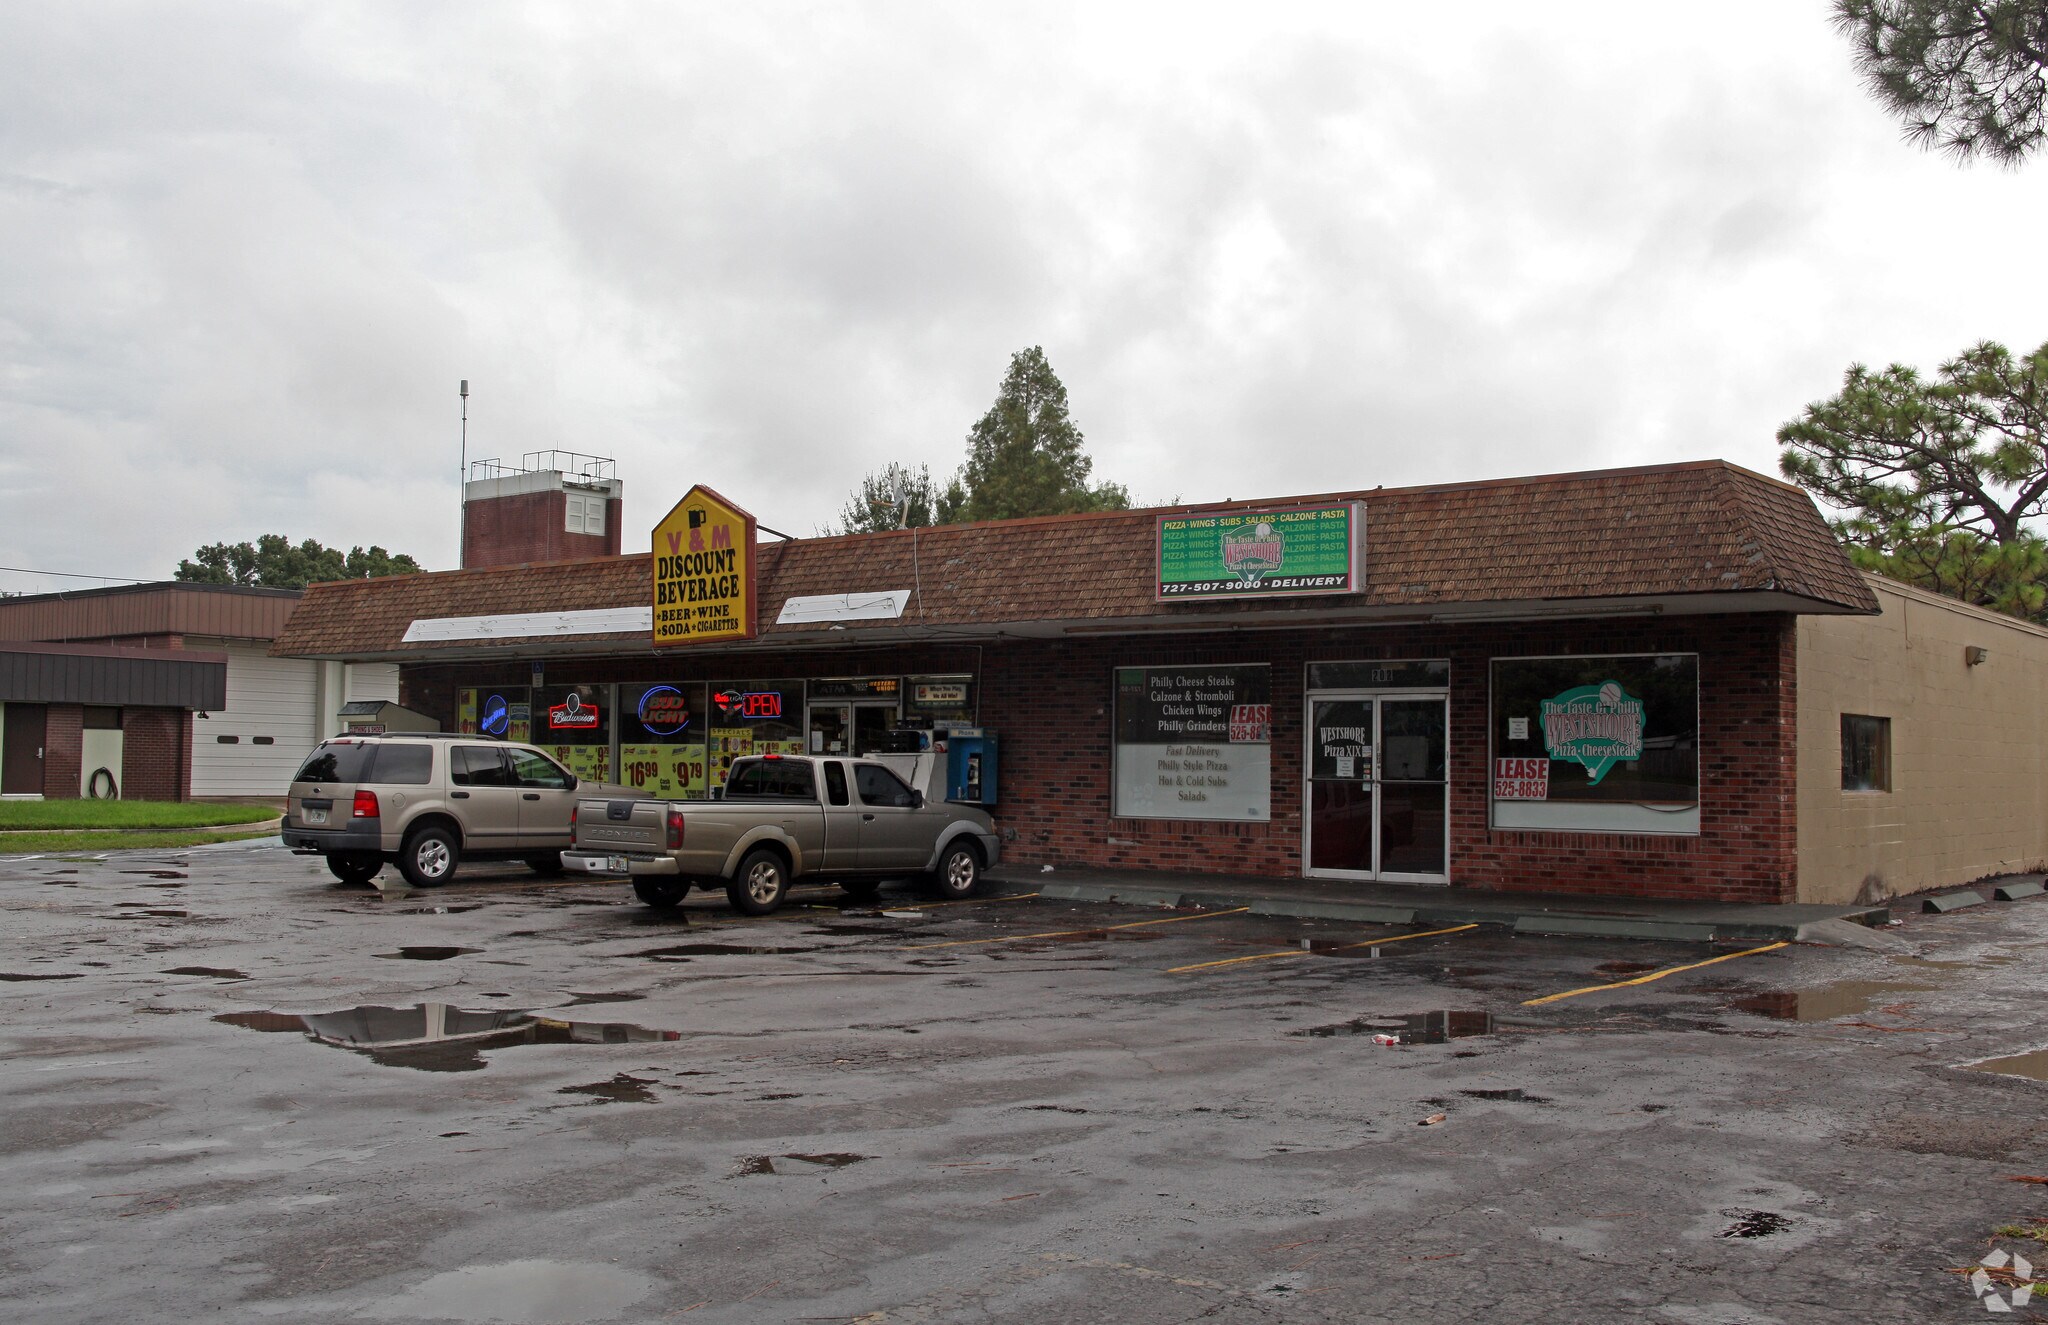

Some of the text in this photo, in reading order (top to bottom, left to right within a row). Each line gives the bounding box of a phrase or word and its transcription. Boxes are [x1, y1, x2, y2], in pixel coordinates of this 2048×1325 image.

[1164, 510, 1345, 530] PIZZA WINGS SUBS SALADS CALZONE PASTA
[1163, 532, 1186, 540] PIZZA
[1189, 530, 1214, 539] WINGS
[1320, 521, 1346, 530] PASTA
[666, 524, 731, 555] V & M
[1163, 531, 1345, 550] PIZZA WINGS ALZONE PASTA
[1237, 535, 1254, 543] Taste
[1263, 534, 1280, 543] Philly
[1163, 542, 1345, 560] PIZZA WINGS ALZONE PASTA
[1225, 542, 1281, 565] WESTSHORE
[658, 548, 736, 580] DISCOUNT
[1284, 555, 1317, 563] ALZONE
[657, 574, 739, 605] BEVERAGE
[1162, 576, 1345, 593] 727-507-9000 DELIVERY
[1151, 675, 1235, 689] Philly Cheese Steaks
[649, 696, 684, 710] BUD
[1150, 690, 1235, 702] Calzone & Stromboli
[744, 694, 780, 716] OPEN
[1162, 704, 1222, 717] Chicken Wings
[1544, 702, 1563, 714] The
[1565, 702, 1592, 714] Taste
[1610, 700, 1640, 713] Philly
[640, 710, 689, 723] LIGHT
[712, 728, 751, 736] SPECIALS
[1158, 720, 1227, 733] Philly Grinders
[1544, 713, 1641, 750] WESTSHORE
[1320, 726, 1366, 745] WESTSHORE
[1166, 745, 1220, 758] Fast Delivery
[1324, 745, 1345, 757] Pizza
[1346, 745, 1361, 757] XIX
[1553, 744, 1577, 756] Pizza
[1157, 760, 1228, 772] Philly Style Pizza
[1496, 759, 1547, 780] LEASE
[1158, 775, 1228, 787] Hot & Cold Subs
[1178, 790, 1207, 801] Salads
[1495, 780, 1546, 798] 525-8833
[591, 829, 650, 838] FRONTIER
